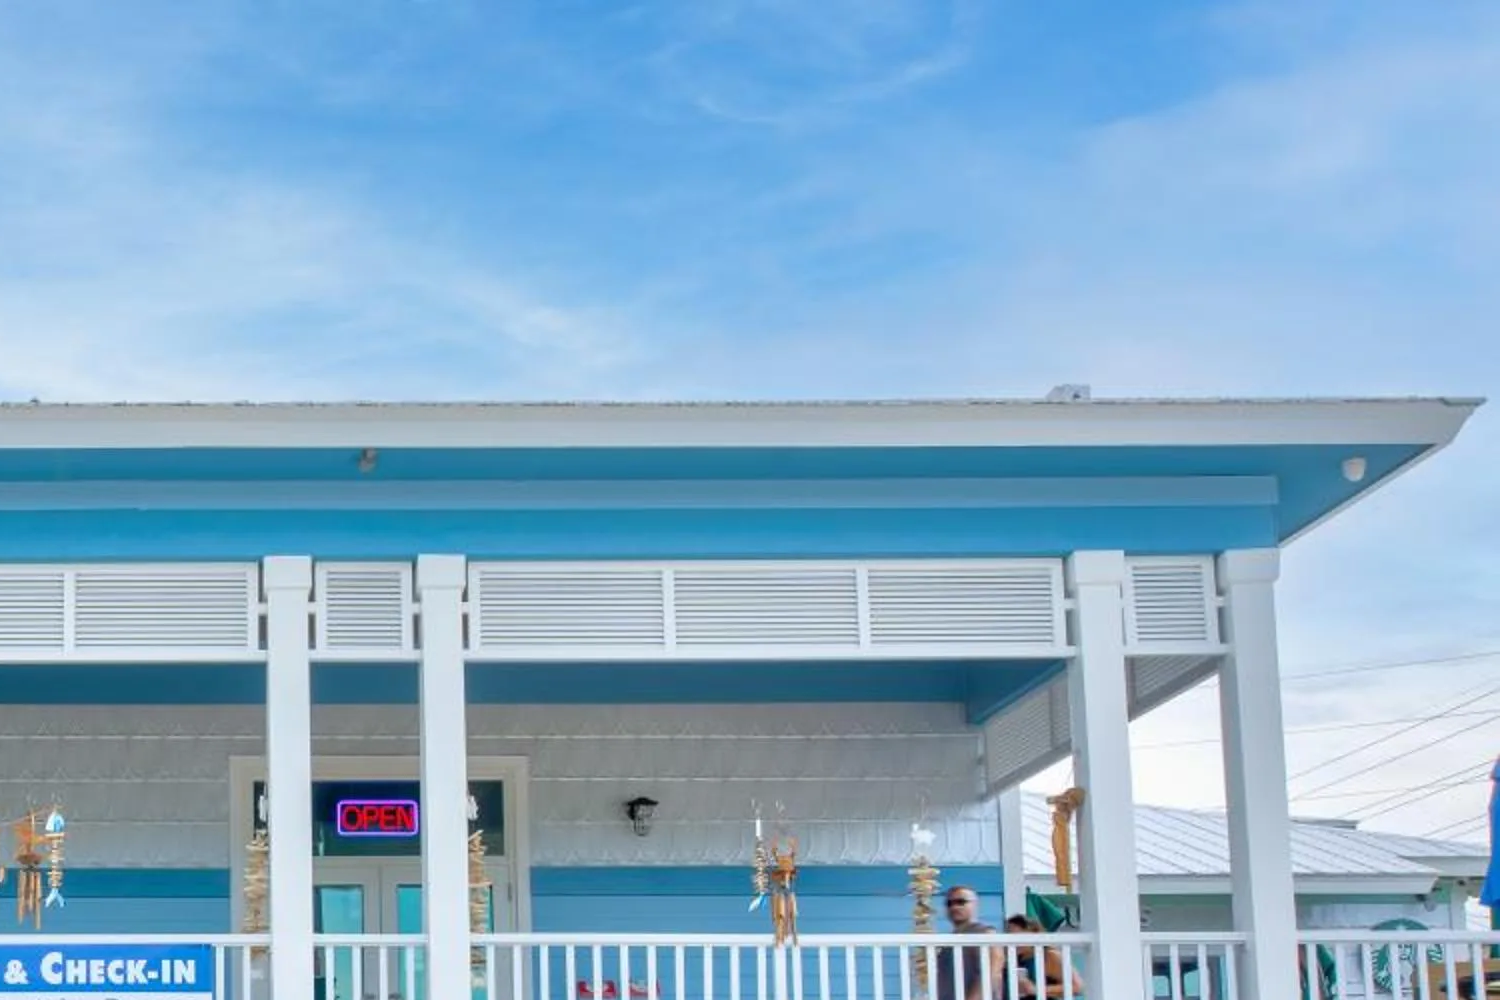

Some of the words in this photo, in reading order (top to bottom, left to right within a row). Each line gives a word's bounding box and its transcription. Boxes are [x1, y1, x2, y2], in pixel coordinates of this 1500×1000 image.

[341, 805, 415, 832] OPEN
[3, 959, 29, 985] &
[40, 951, 196, 985] CHECK-IN
